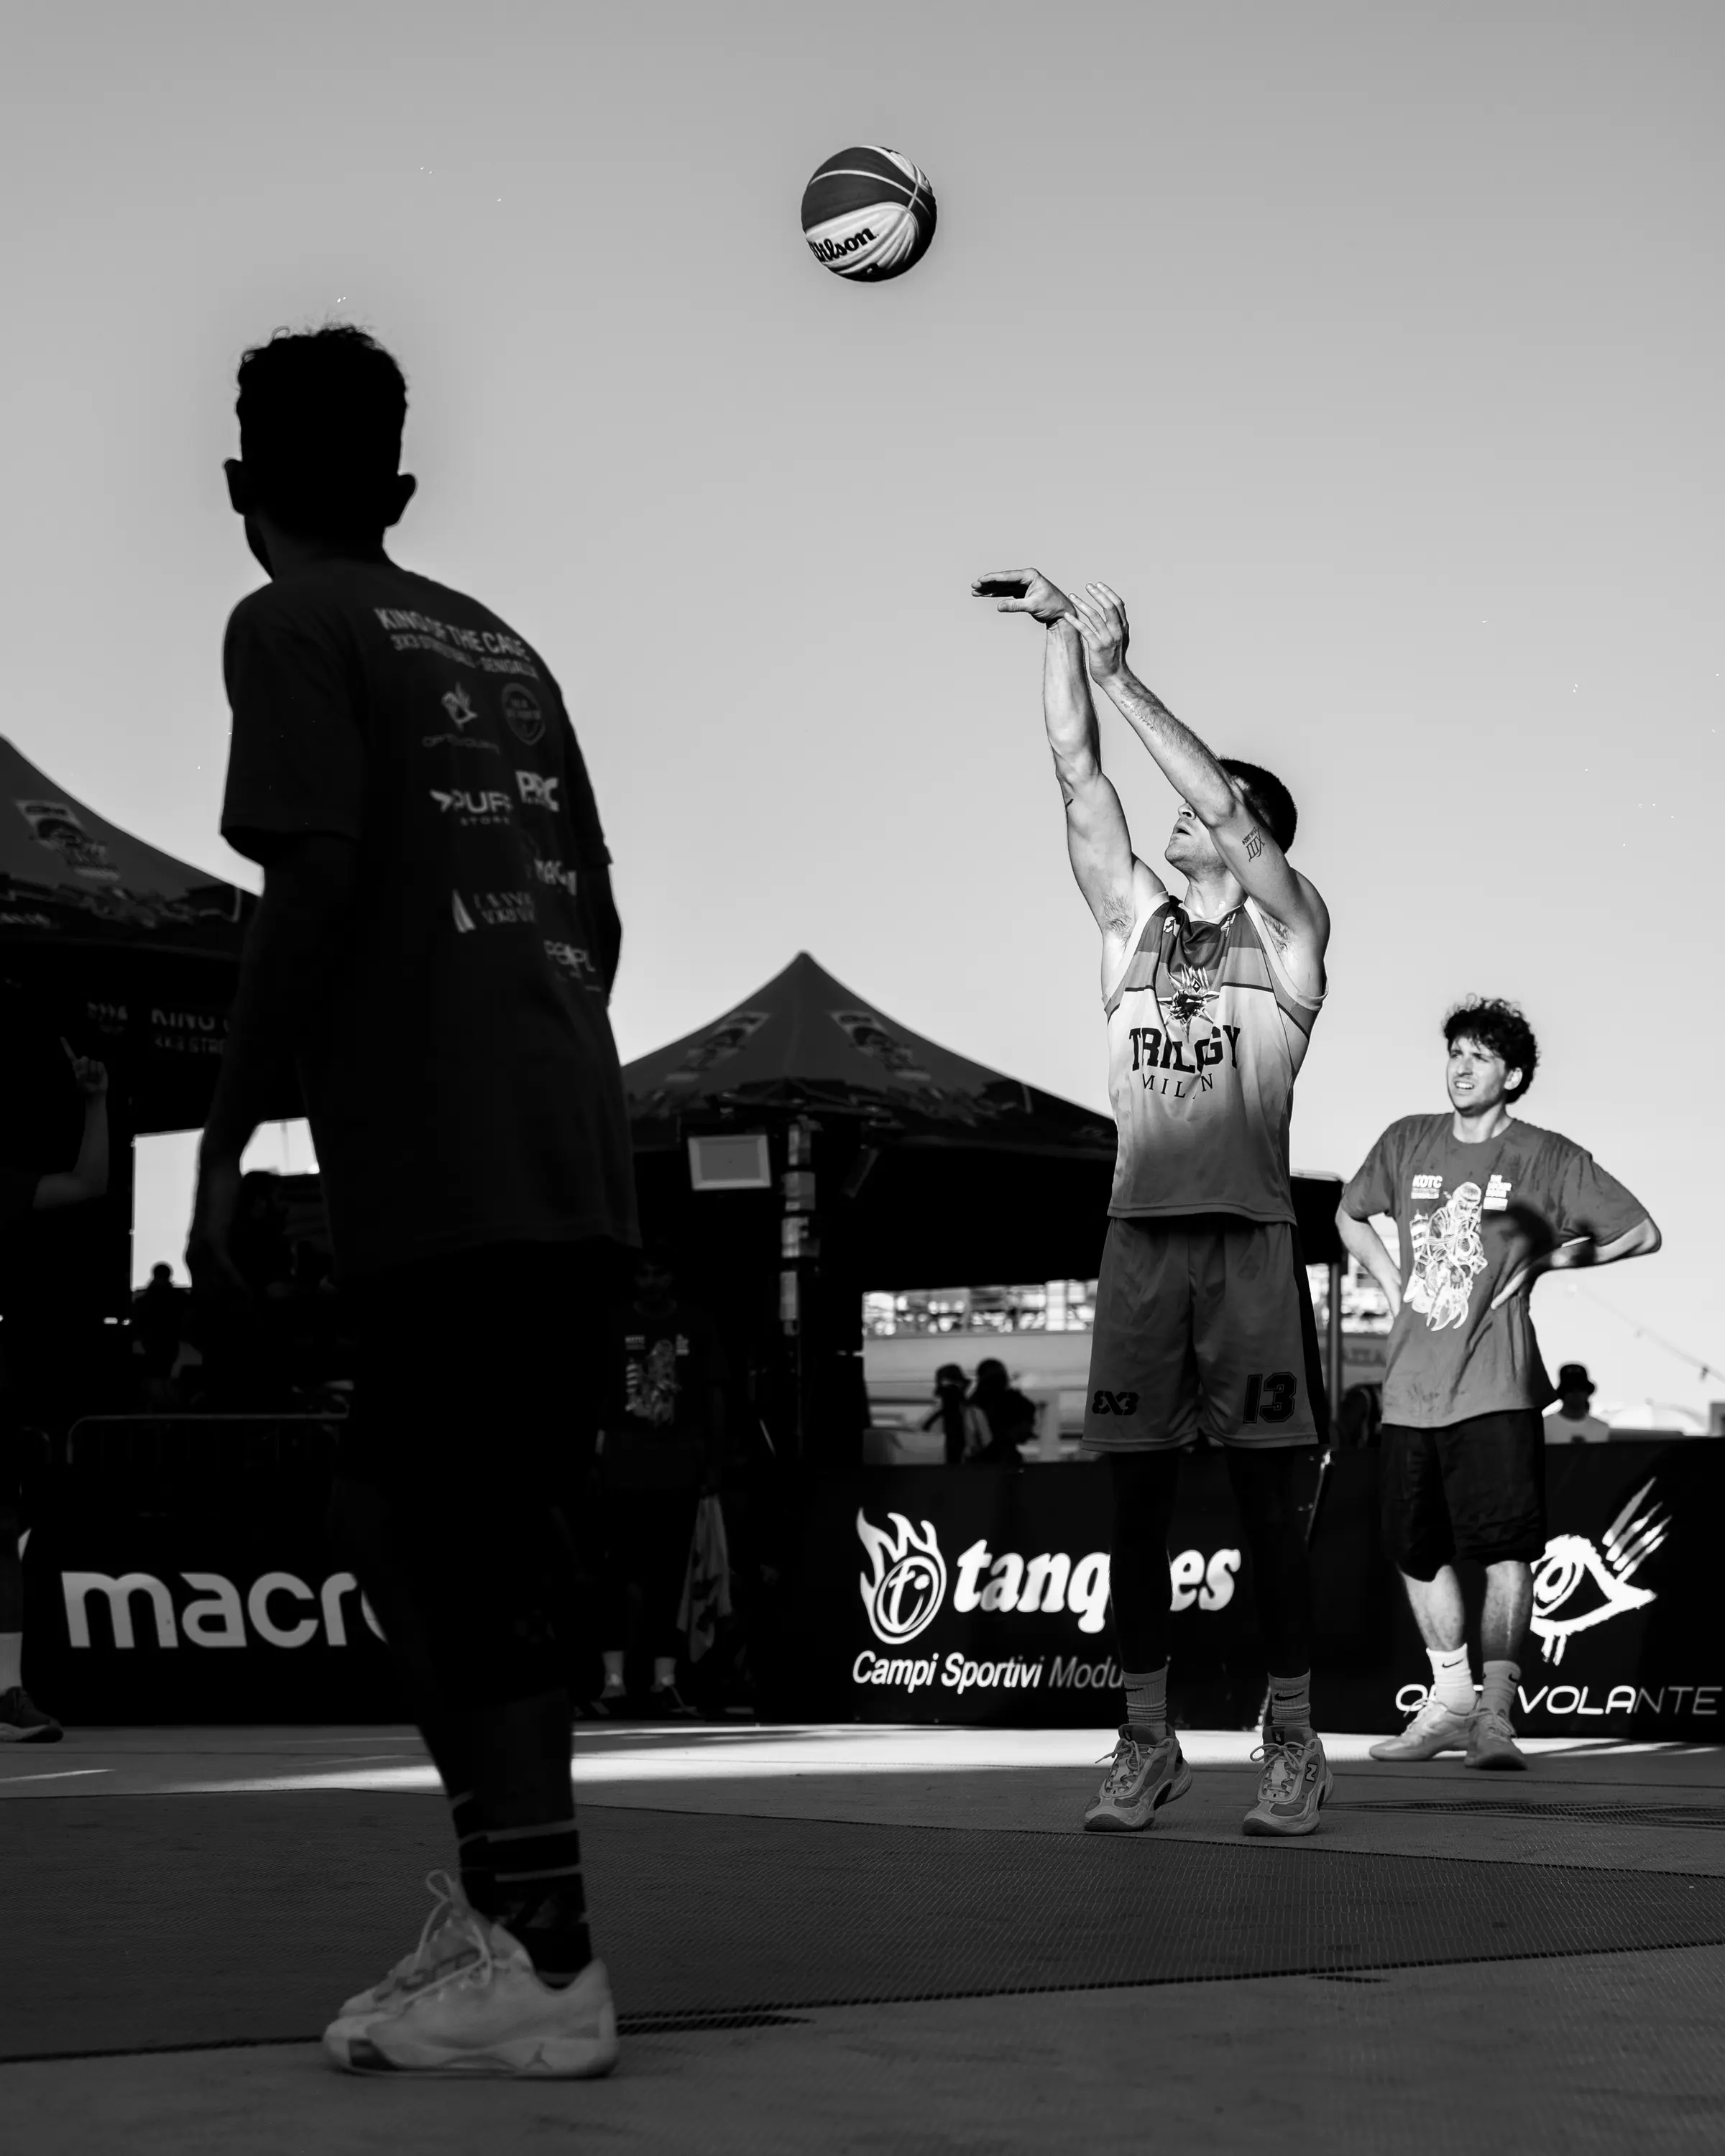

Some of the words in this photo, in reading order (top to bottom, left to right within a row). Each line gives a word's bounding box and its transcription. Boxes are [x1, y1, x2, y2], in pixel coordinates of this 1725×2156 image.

[1142, 1073, 1213, 1100] MILN
[1412, 1174, 1443, 1189] KOTC
[1243, 1372, 1297, 1424] 13
[60, 1570, 390, 1649] macr
[953, 1539, 1242, 1634] tanqes
[852, 1649, 939, 1694] Campi
[940, 1651, 1045, 1695] Sportivi
[1047, 1655, 1123, 1690] Modu
[1517, 1685, 1724, 1715] VOLANTE
